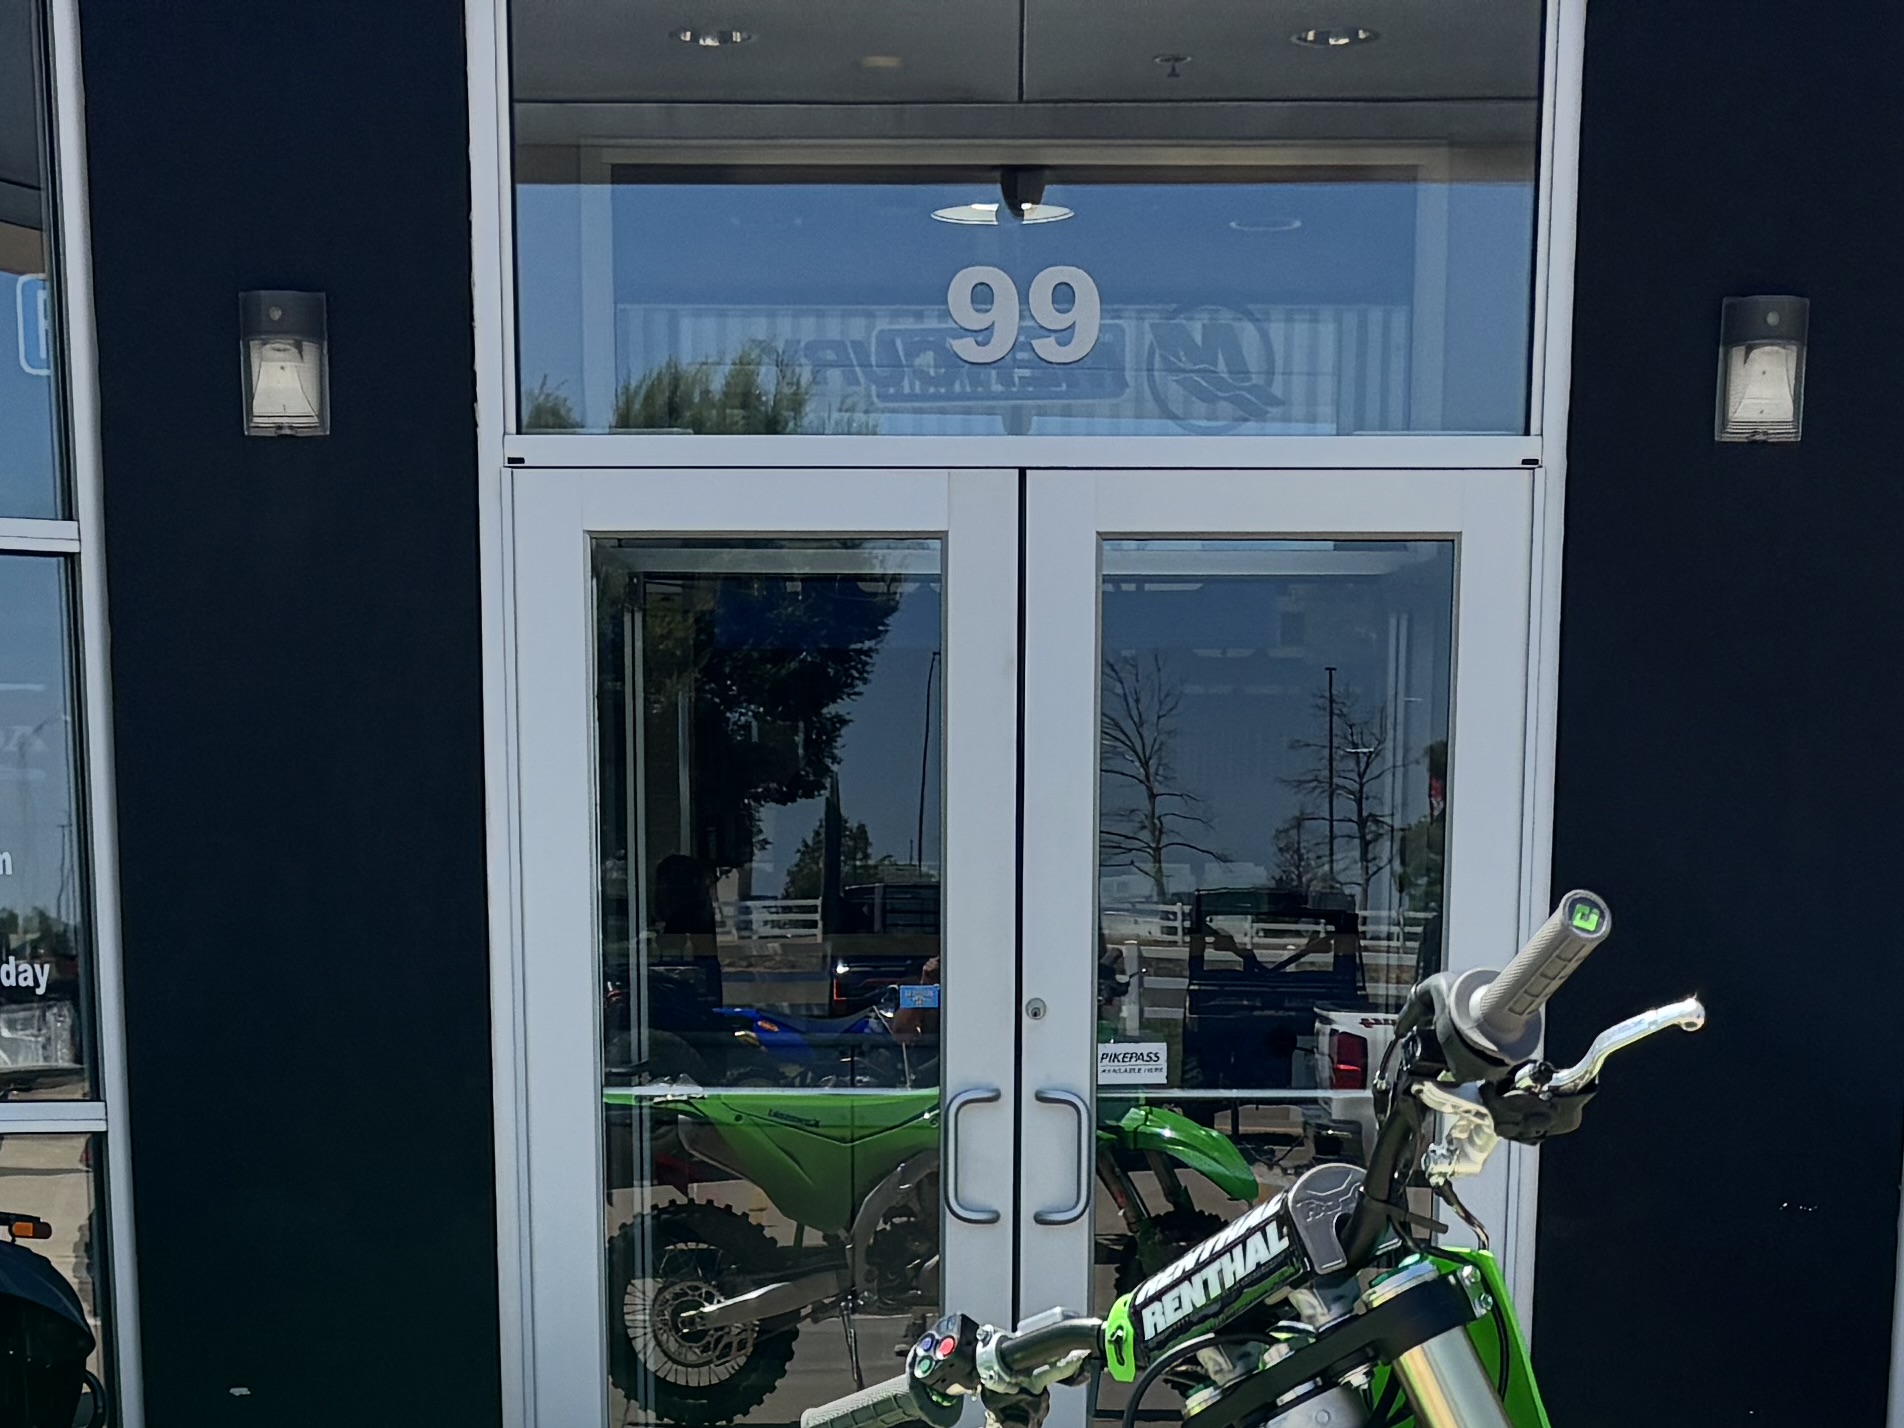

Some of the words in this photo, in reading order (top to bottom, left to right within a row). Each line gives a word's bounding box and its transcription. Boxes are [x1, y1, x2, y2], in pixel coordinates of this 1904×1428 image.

[947, 265, 1100, 364] 99
[1100, 1051, 1160, 1064] PIKEPASS
[1142, 1220, 1290, 1341] RENTHAL
